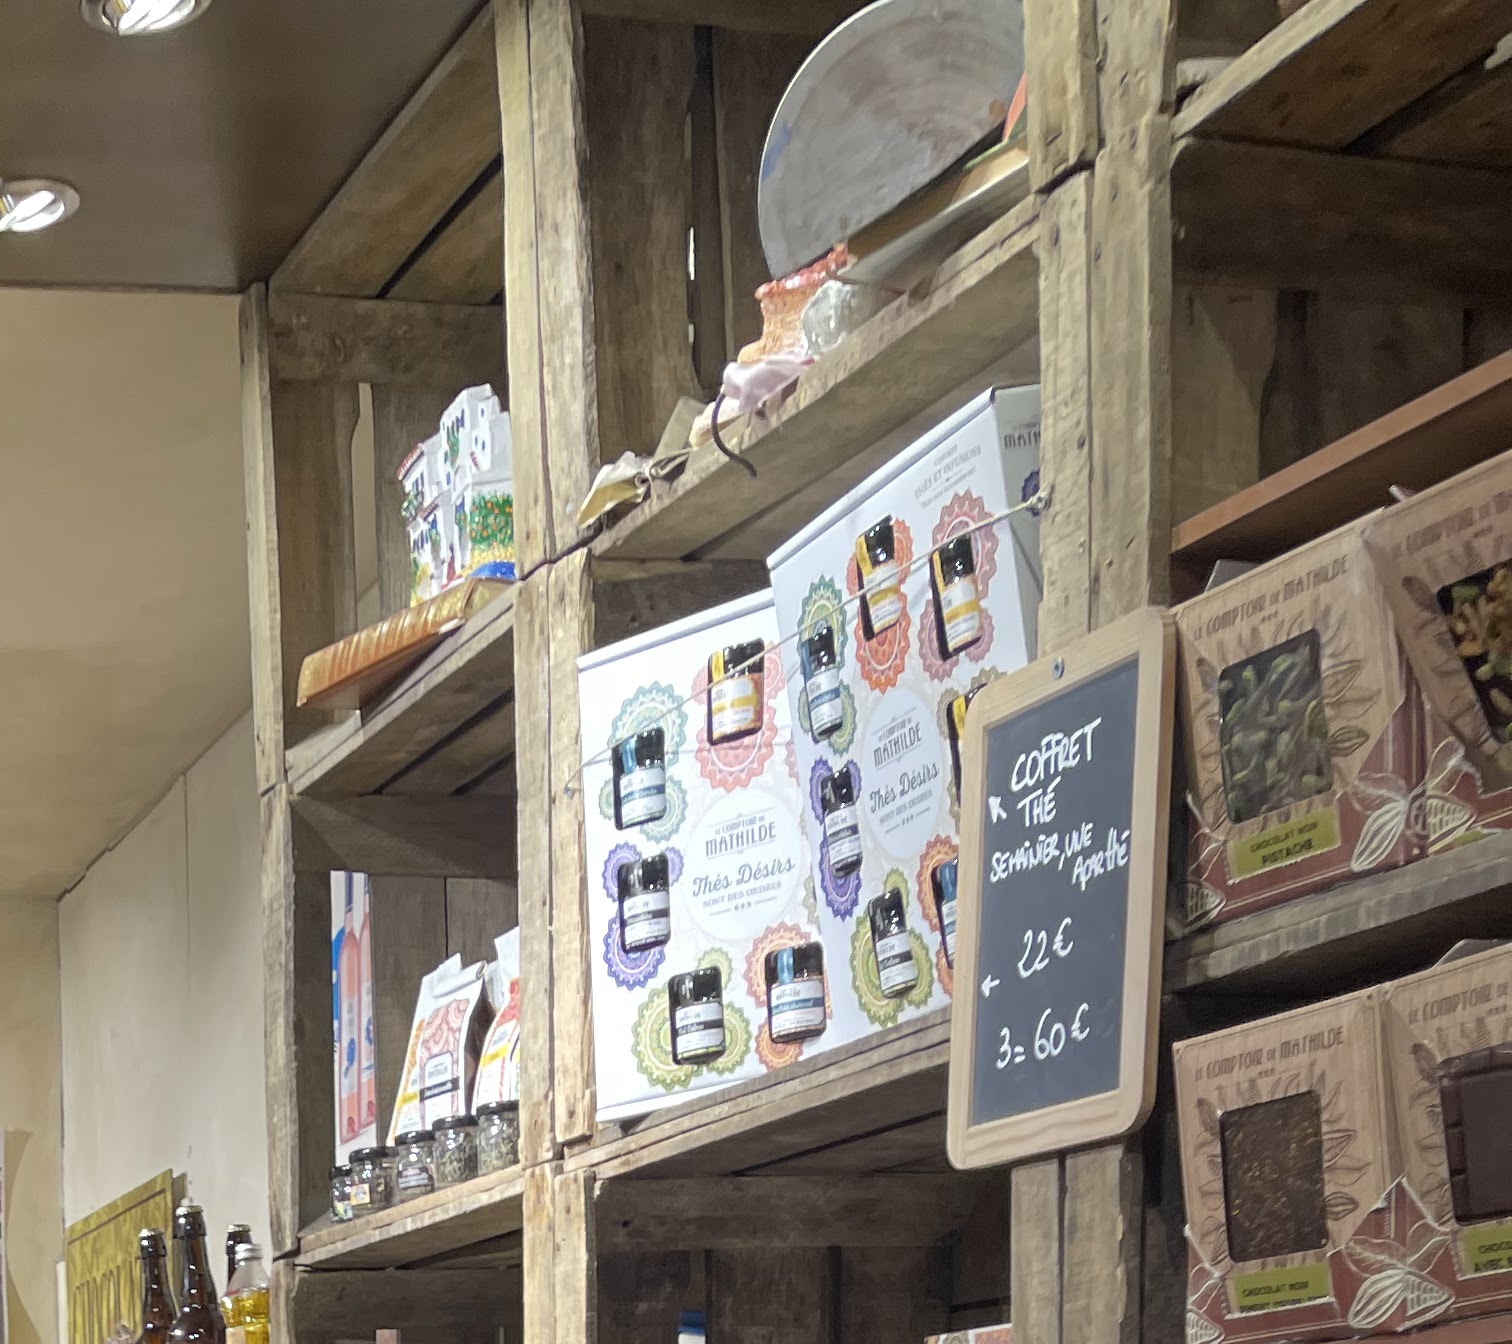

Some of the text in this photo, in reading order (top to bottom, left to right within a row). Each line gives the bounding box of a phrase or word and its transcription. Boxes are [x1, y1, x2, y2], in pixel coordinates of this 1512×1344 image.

[1206, 593, 1267, 637] COMPTOIR
[1282, 553, 1349, 602] MATHILDE
[873, 722, 922, 767] MATHILDE
[1010, 717, 1102, 793] COFFRET
[869, 762, 940, 814] Thés Désirs
[1018, 776, 1062, 829] THÉ
[705, 821, 777, 857] MATHILDE
[692, 857, 796, 897] Thés Désirs
[1206, 1048, 1262, 1080] COMPTOIR
[1280, 1025, 1345, 1059] MATHILDE
